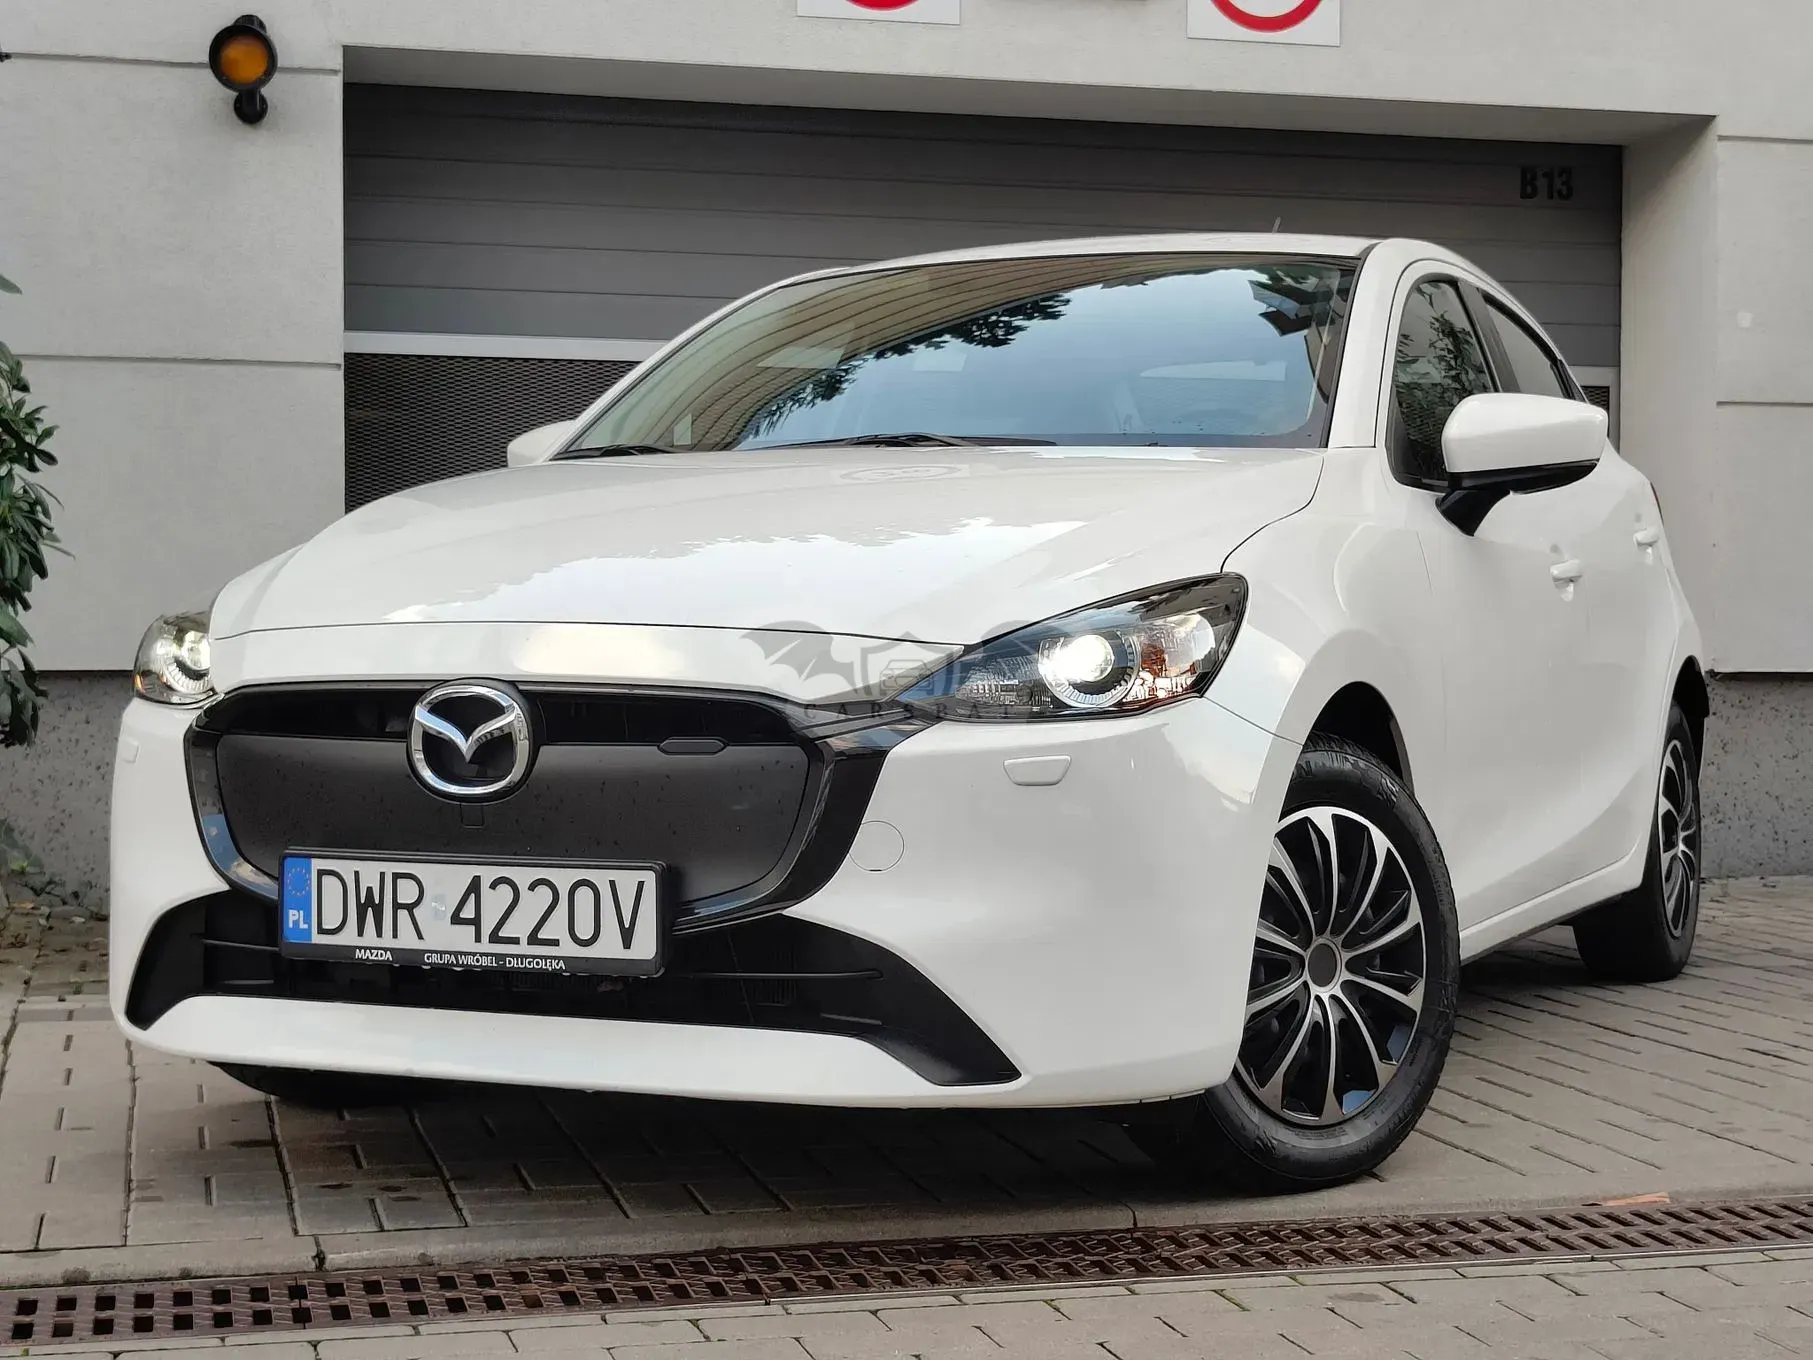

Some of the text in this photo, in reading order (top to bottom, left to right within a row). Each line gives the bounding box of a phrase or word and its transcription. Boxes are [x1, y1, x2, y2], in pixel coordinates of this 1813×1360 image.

[1520, 166, 1574, 200] B13
[288, 909, 309, 929] PL
[316, 868, 646, 950] DWR 4220V
[355, 948, 393, 961] MAZDA
[424, 952, 457, 965] GRUPA
[458, 953, 498, 967] WRÓBEL
